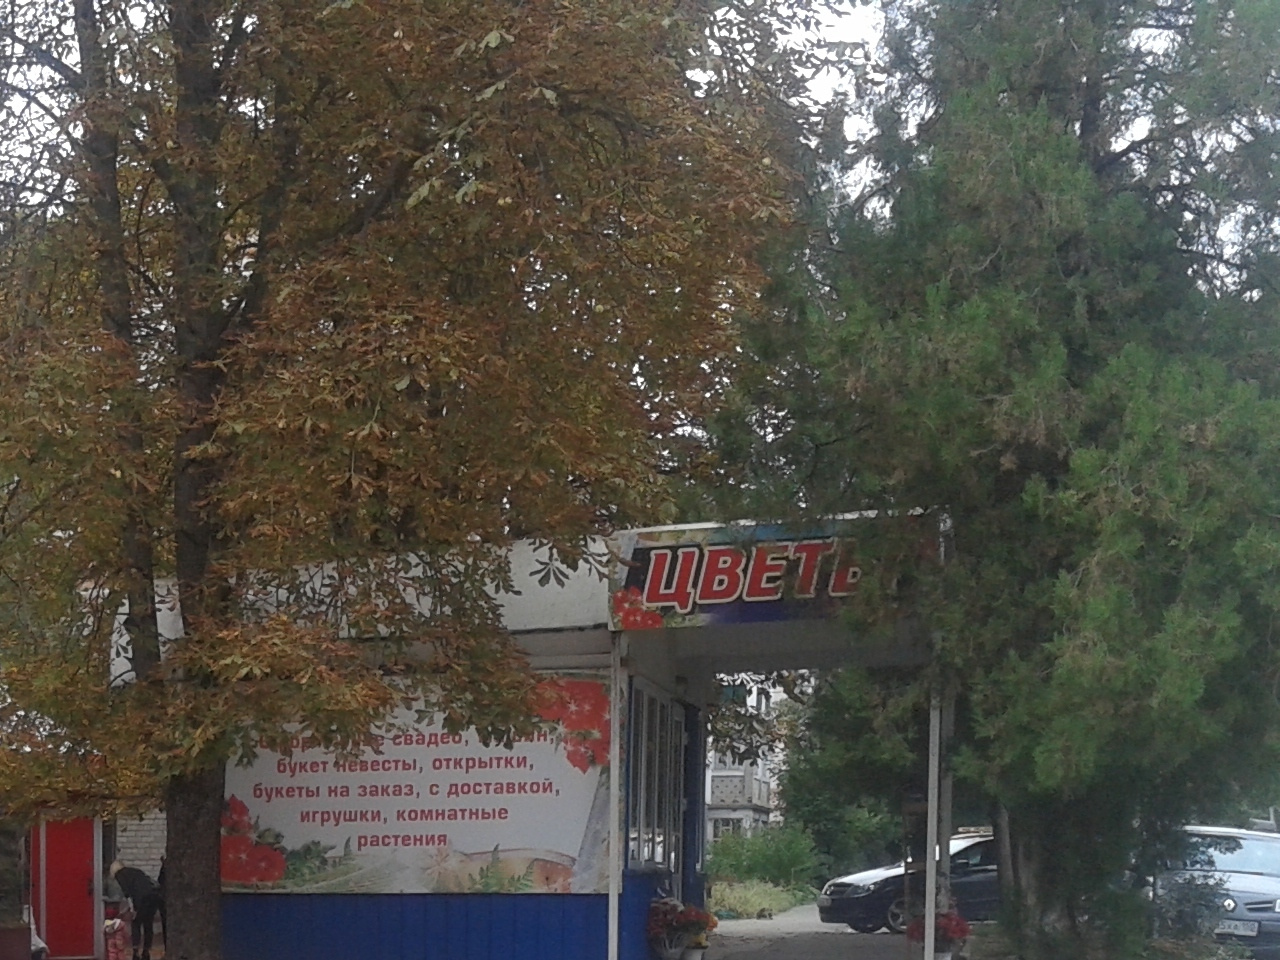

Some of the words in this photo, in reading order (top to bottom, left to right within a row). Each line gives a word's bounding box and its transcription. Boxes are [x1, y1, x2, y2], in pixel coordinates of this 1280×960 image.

[276, 757, 329, 779] букет
[335, 755, 423, 776] невесты,
[431, 754, 534, 775] открытки,
[253, 781, 321, 804] букеты
[327, 783, 351, 798] на
[357, 782, 421, 800] заказ,
[429, 783, 440, 797] с
[447, 777, 561, 800] доставкой,
[300, 806, 388, 828] игрушки,
[395, 805, 509, 823] комнатные
[357, 830, 448, 852] растения
